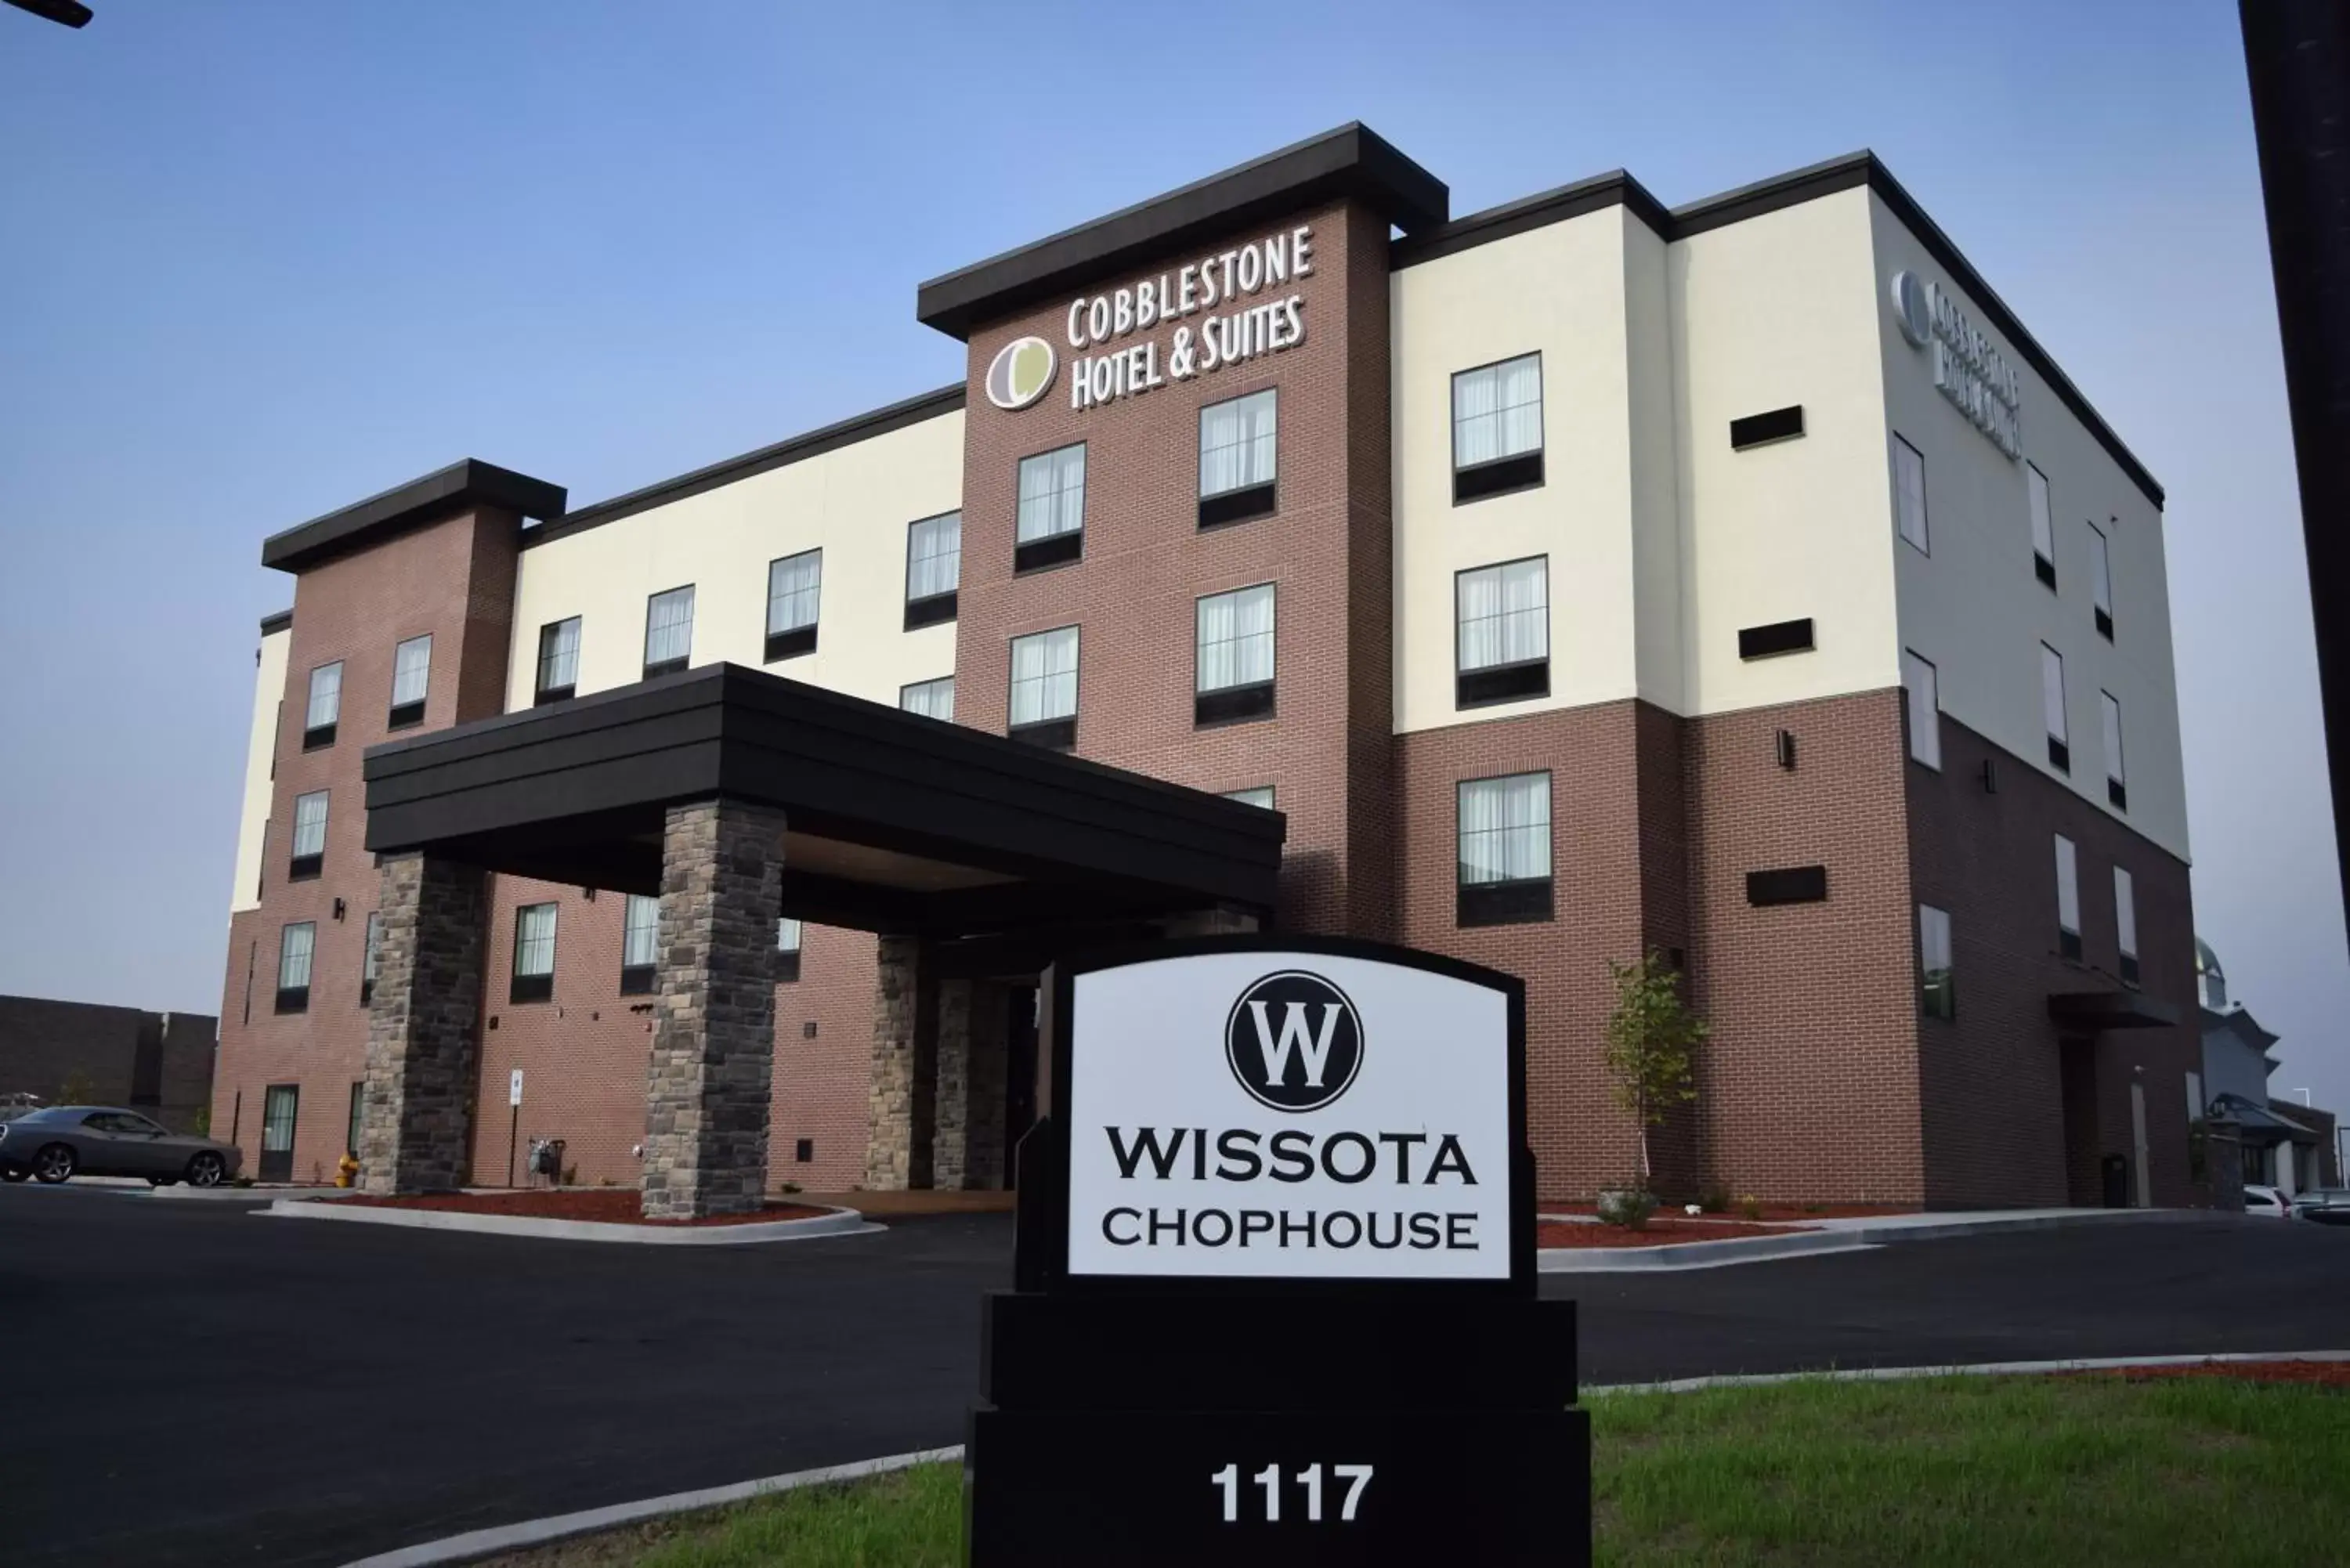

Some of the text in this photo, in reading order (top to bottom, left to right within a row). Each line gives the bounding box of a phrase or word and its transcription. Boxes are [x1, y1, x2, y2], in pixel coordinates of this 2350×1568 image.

[1068, 226, 1314, 349] COBBLESTONE
[1071, 295, 1306, 409] HOTEL & SUITES
[1248, 1000, 1343, 1086] W
[1103, 1125, 1478, 1185] WISSOTA
[1101, 1207, 1479, 1251] CHOPHOUSE
[1212, 1463, 1373, 1521] 1117
